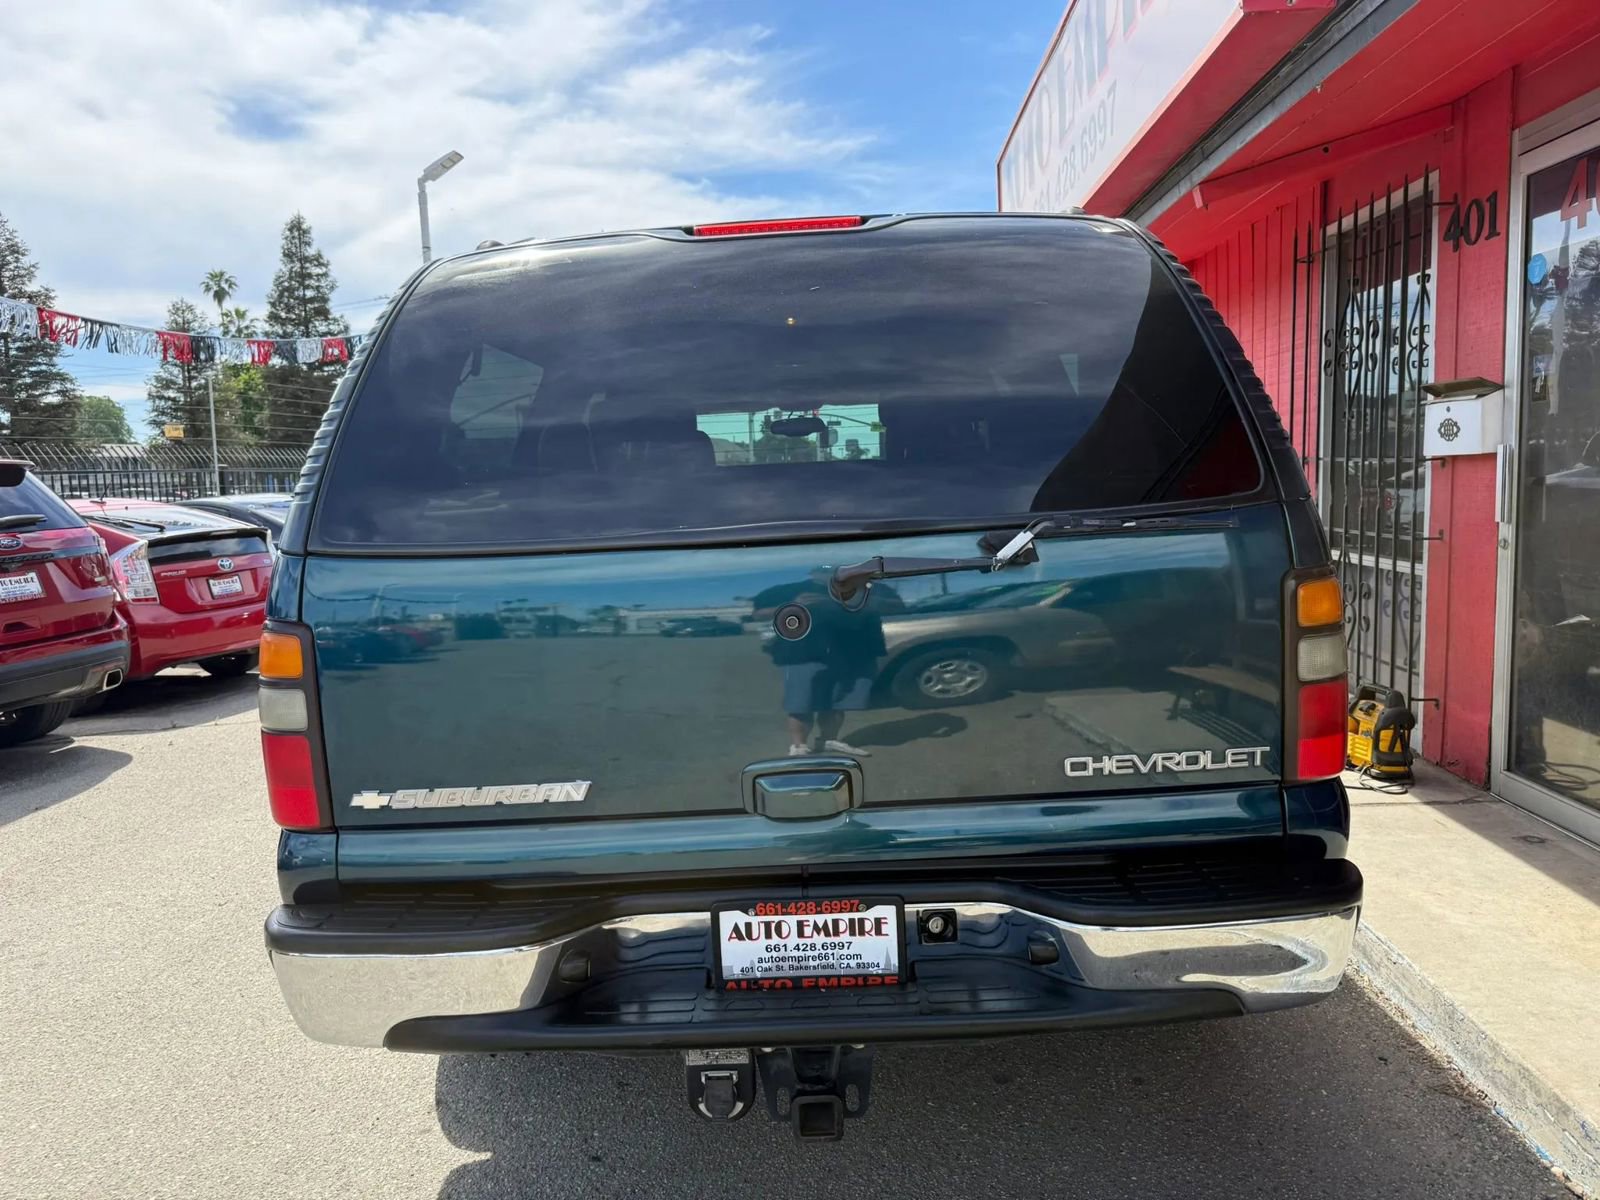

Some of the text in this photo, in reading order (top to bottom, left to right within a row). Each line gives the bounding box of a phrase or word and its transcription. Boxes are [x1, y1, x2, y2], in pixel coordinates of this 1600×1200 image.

[1560, 157, 1600, 230] 4
[1443, 190, 1501, 253] 401
[1064, 746, 1271, 777] CHEVROLET
[389, 779, 592, 809] SUBURBAN
[755, 900, 860, 916] 661-428-6997
[727, 917, 890, 942] AUTO EMPIRE
[757, 952, 863, 964] autoempire661.com
[765, 941, 853, 953] 661.428.6997
[740, 961, 881, 974] 401 Oak St. Bakersfield, CA. 93304
